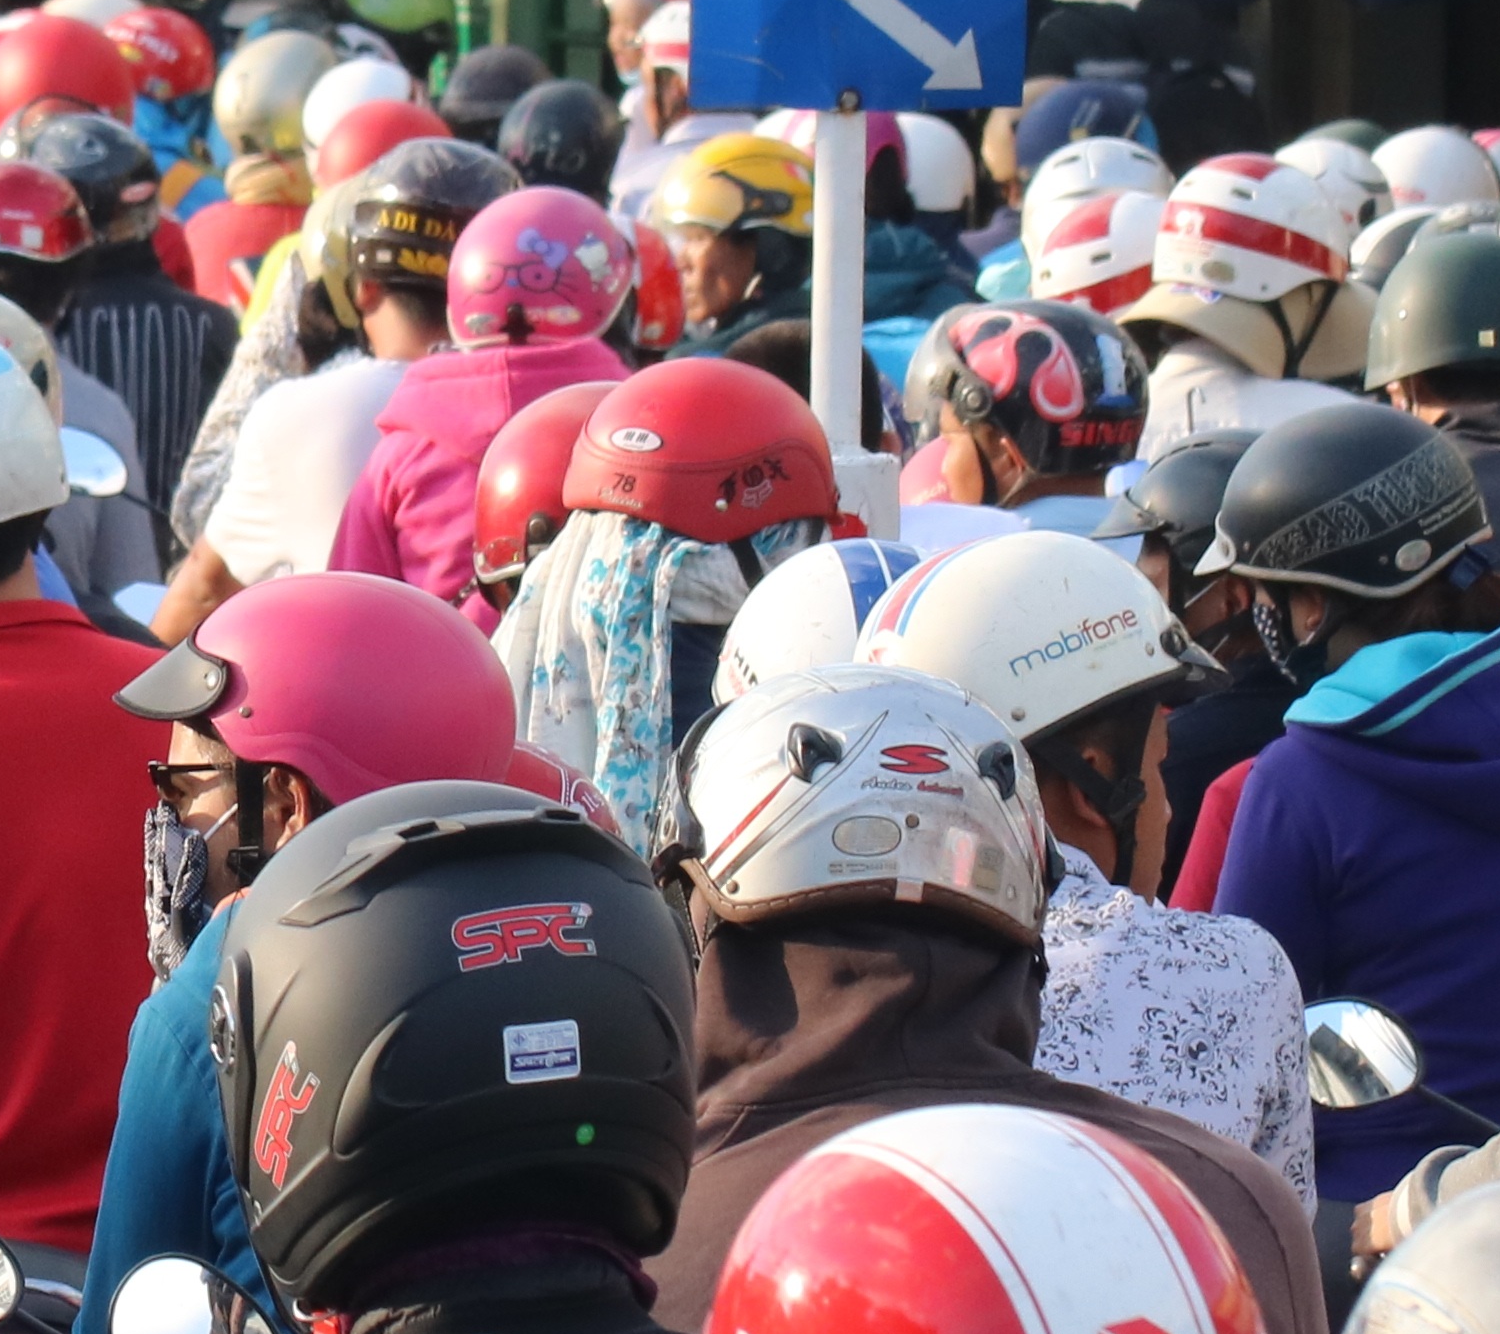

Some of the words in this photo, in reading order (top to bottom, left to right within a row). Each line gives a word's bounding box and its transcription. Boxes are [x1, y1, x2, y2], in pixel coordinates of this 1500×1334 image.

[612, 472, 637, 494] 78
[1008, 608, 1140, 678] mobifone
[452, 902, 598, 971] SPC
[255, 1040, 322, 1192] SPC
